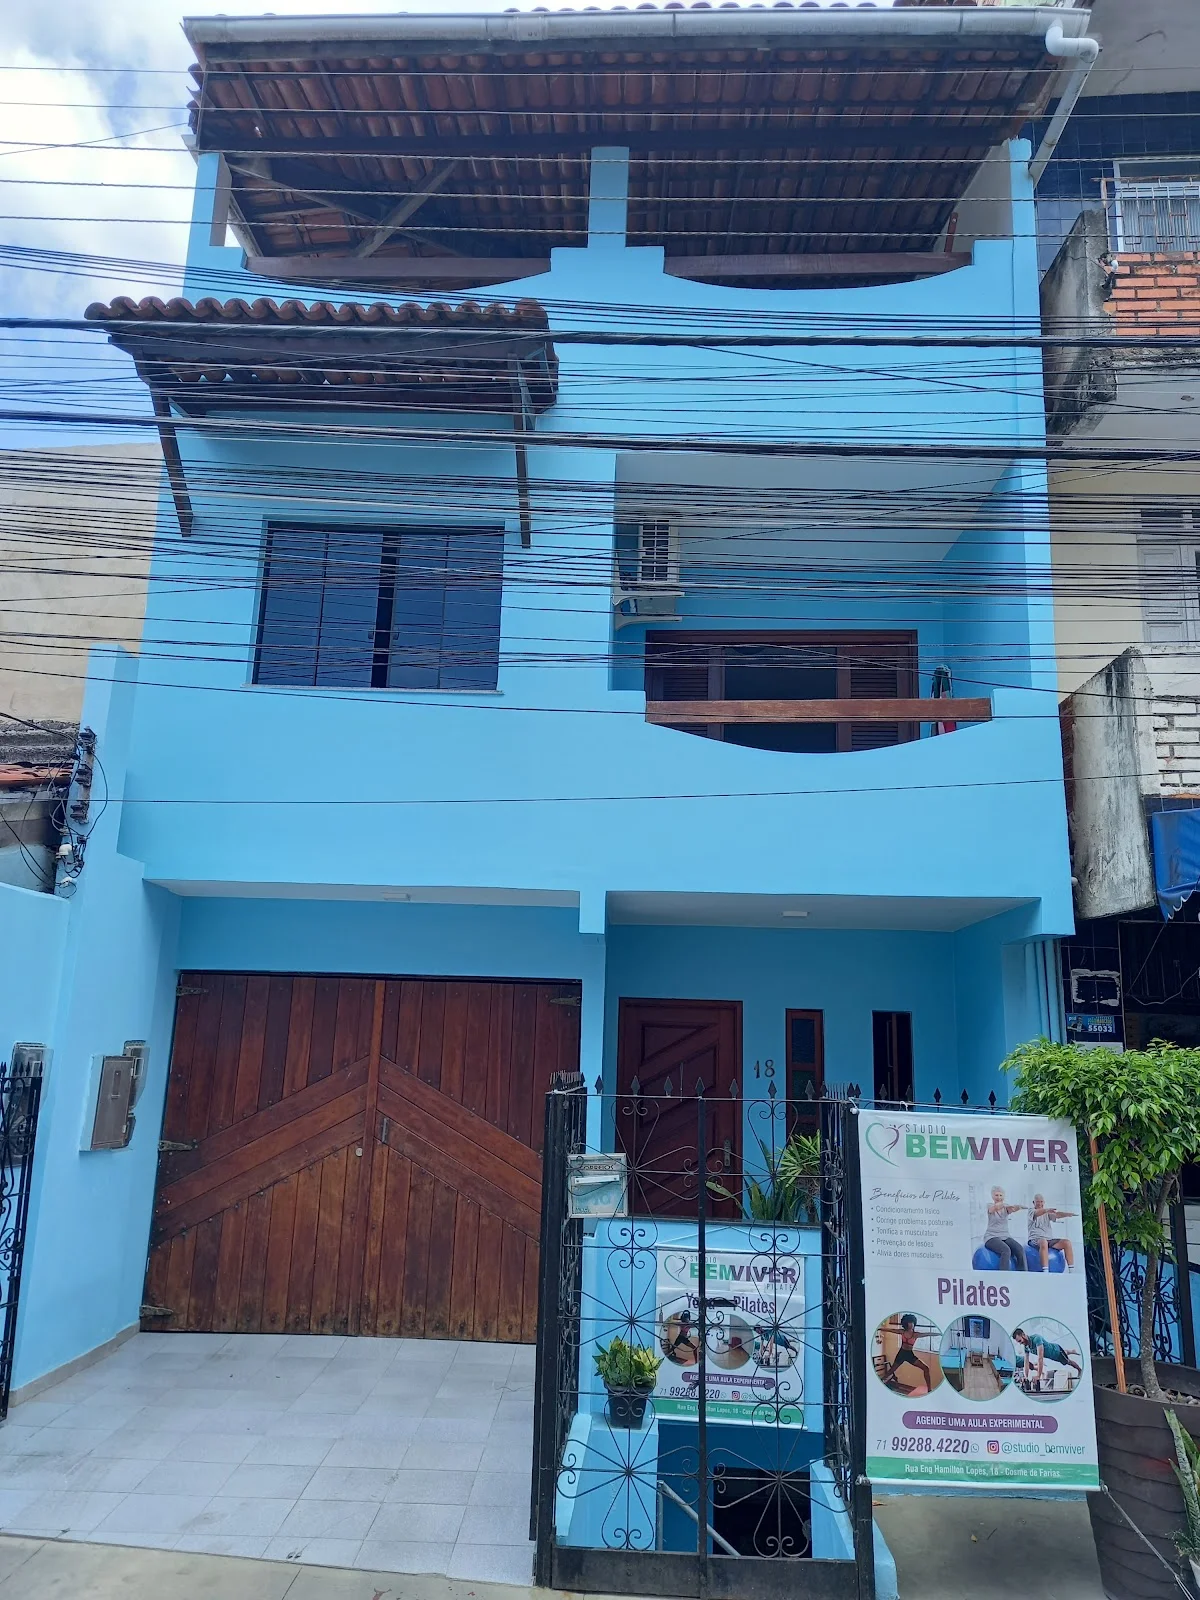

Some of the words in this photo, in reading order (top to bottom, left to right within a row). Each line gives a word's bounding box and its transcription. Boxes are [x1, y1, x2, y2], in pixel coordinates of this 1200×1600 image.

[753, 1059, 775, 1079] 18
[905, 1124, 946, 1134] STUDIO
[906, 1134, 1070, 1163] BEMVIVER
[1024, 1163, 1073, 1173] PILATES
[919, 1191, 930, 1199] do
[932, 1190, 960, 1201] Pilates
[876, 1216, 897, 1225] Corrige
[898, 1217, 927, 1226] problemas
[928, 1219, 954, 1227] posturais
[876, 1227, 898, 1235] Tonifica
[904, 1229, 938, 1237] musculatura
[876, 1238, 906, 1247] Prevenção
[915, 1239, 934, 1248] lesões
[690, 1255, 717, 1263] STDIO
[893, 1250, 910, 1258] dores
[937, 1278, 1010, 1307] Pilates
[733, 1295, 776, 1314] Pilates
[669, 1386, 720, 1399] 99288.220
[916, 1415, 946, 1426] AGENDE
[948, 1416, 966, 1427] UMA
[968, 1417, 987, 1428] AULA
[989, 1418, 1045, 1429] EXPERIMENTAL
[876, 1439, 887, 1450] 71
[891, 1436, 970, 1454] 99288.4220
[1001, 1441, 1086, 1457] @studio_bemviver
[905, 1463, 919, 1473] Rua
[920, 1464, 933, 1475] Eng
[1005, 1468, 1028, 1477] Cosme
[1029, 1468, 1038, 1477] de
